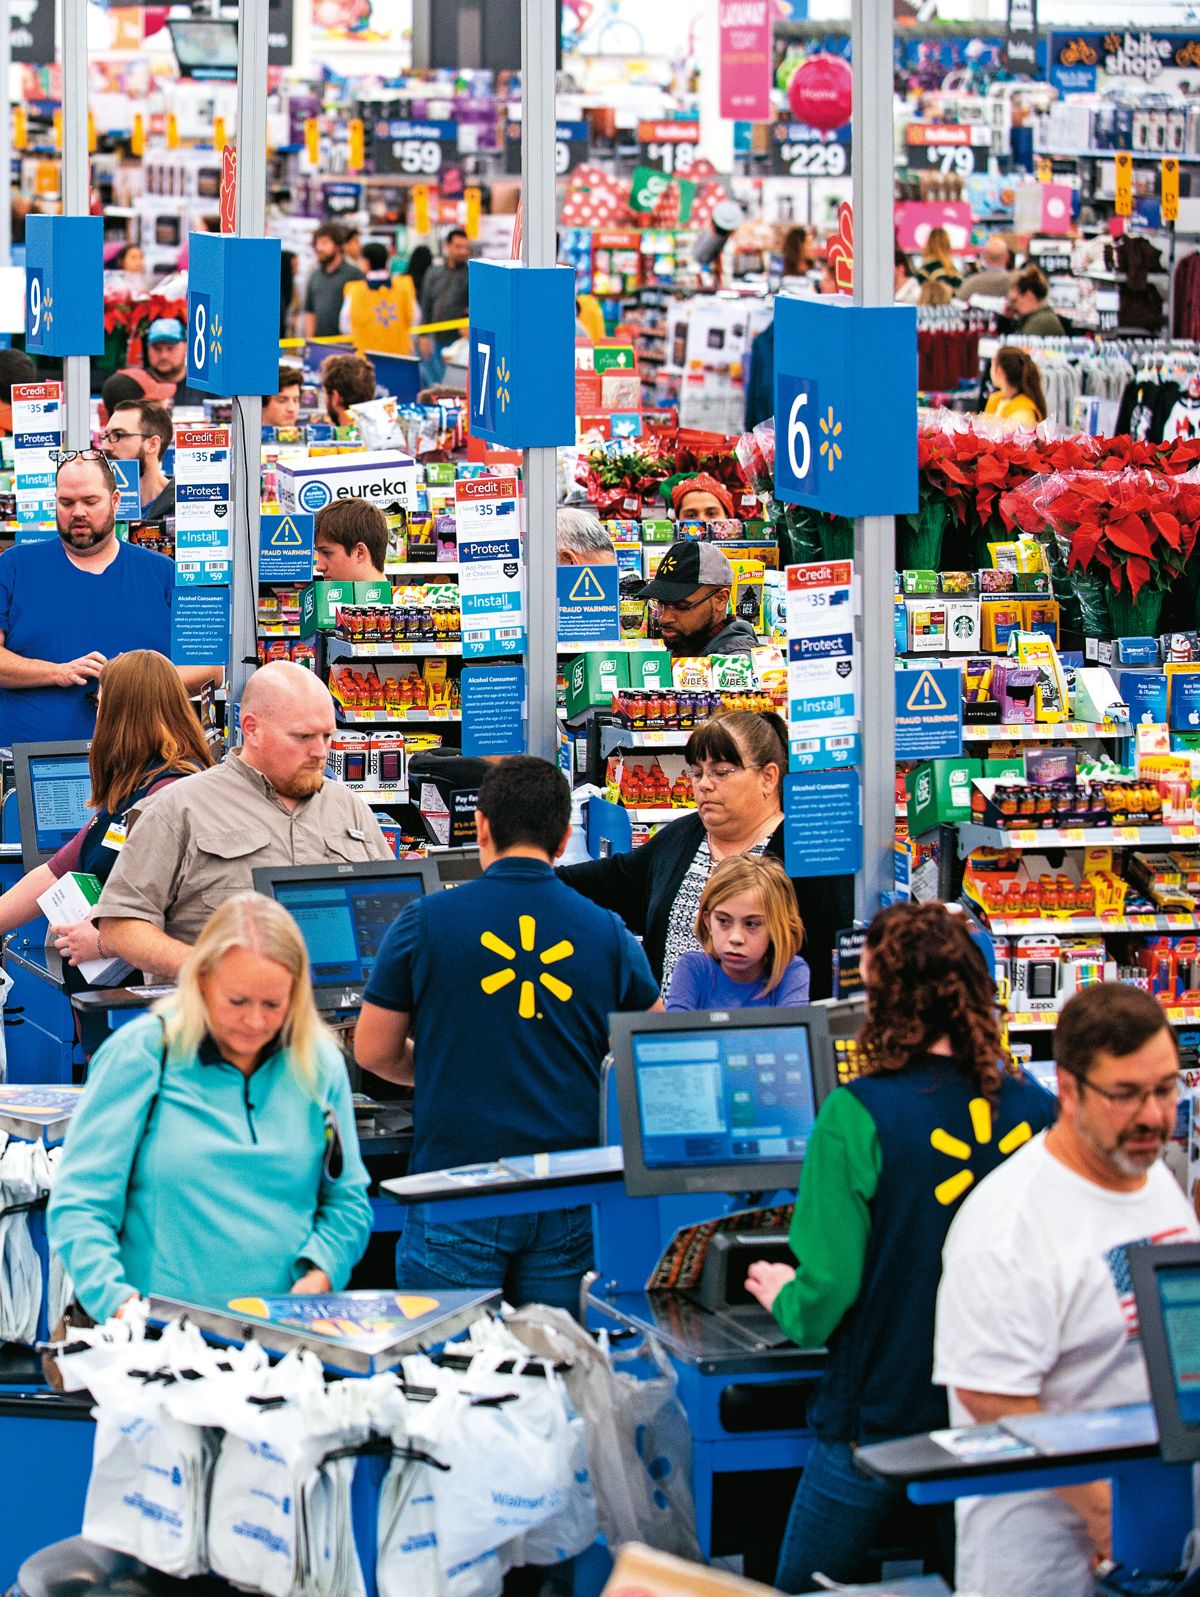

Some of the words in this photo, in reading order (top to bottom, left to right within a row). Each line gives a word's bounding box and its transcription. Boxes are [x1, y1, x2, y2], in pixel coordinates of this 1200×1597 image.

[1122, 30, 1172, 58] bike
[1104, 52, 1163, 82] shop
[392, 142, 442, 174] $59
[780, 144, 846, 176] $229
[927, 146, 975, 176] $79
[30, 278, 41, 336] 9
[194, 303, 206, 370] 8
[477, 342, 490, 415] 7
[20, 386, 45, 396] Credit
[27, 404, 42, 413] $35
[23, 434, 54, 444] Protect
[185, 432, 213, 442] Credit
[787, 392, 811, 479] 6
[192, 452, 208, 462] $35
[25, 473, 53, 485] Install
[186, 486, 220, 495] Protect
[336, 478, 406, 498] eureka
[465, 483, 498, 494] Credit
[23, 511, 34, 520] $79
[475, 505, 493, 515] $35
[187, 532, 217, 542] Install
[470, 543, 510, 554] Protect
[738, 572, 751, 580] Little
[796, 568, 832, 582] Credit
[474, 595, 508, 608] Install
[807, 594, 826, 606] $35
[470, 643, 484, 652] $79
[502, 641, 515, 650] $59
[801, 637, 843, 652] Protect
[804, 698, 840, 713] Install
[923, 714, 959, 724] WARNING
[798, 754, 813, 765] $79
[832, 751, 848, 761] $59
[1030, 1001, 1054, 1009] zippo
